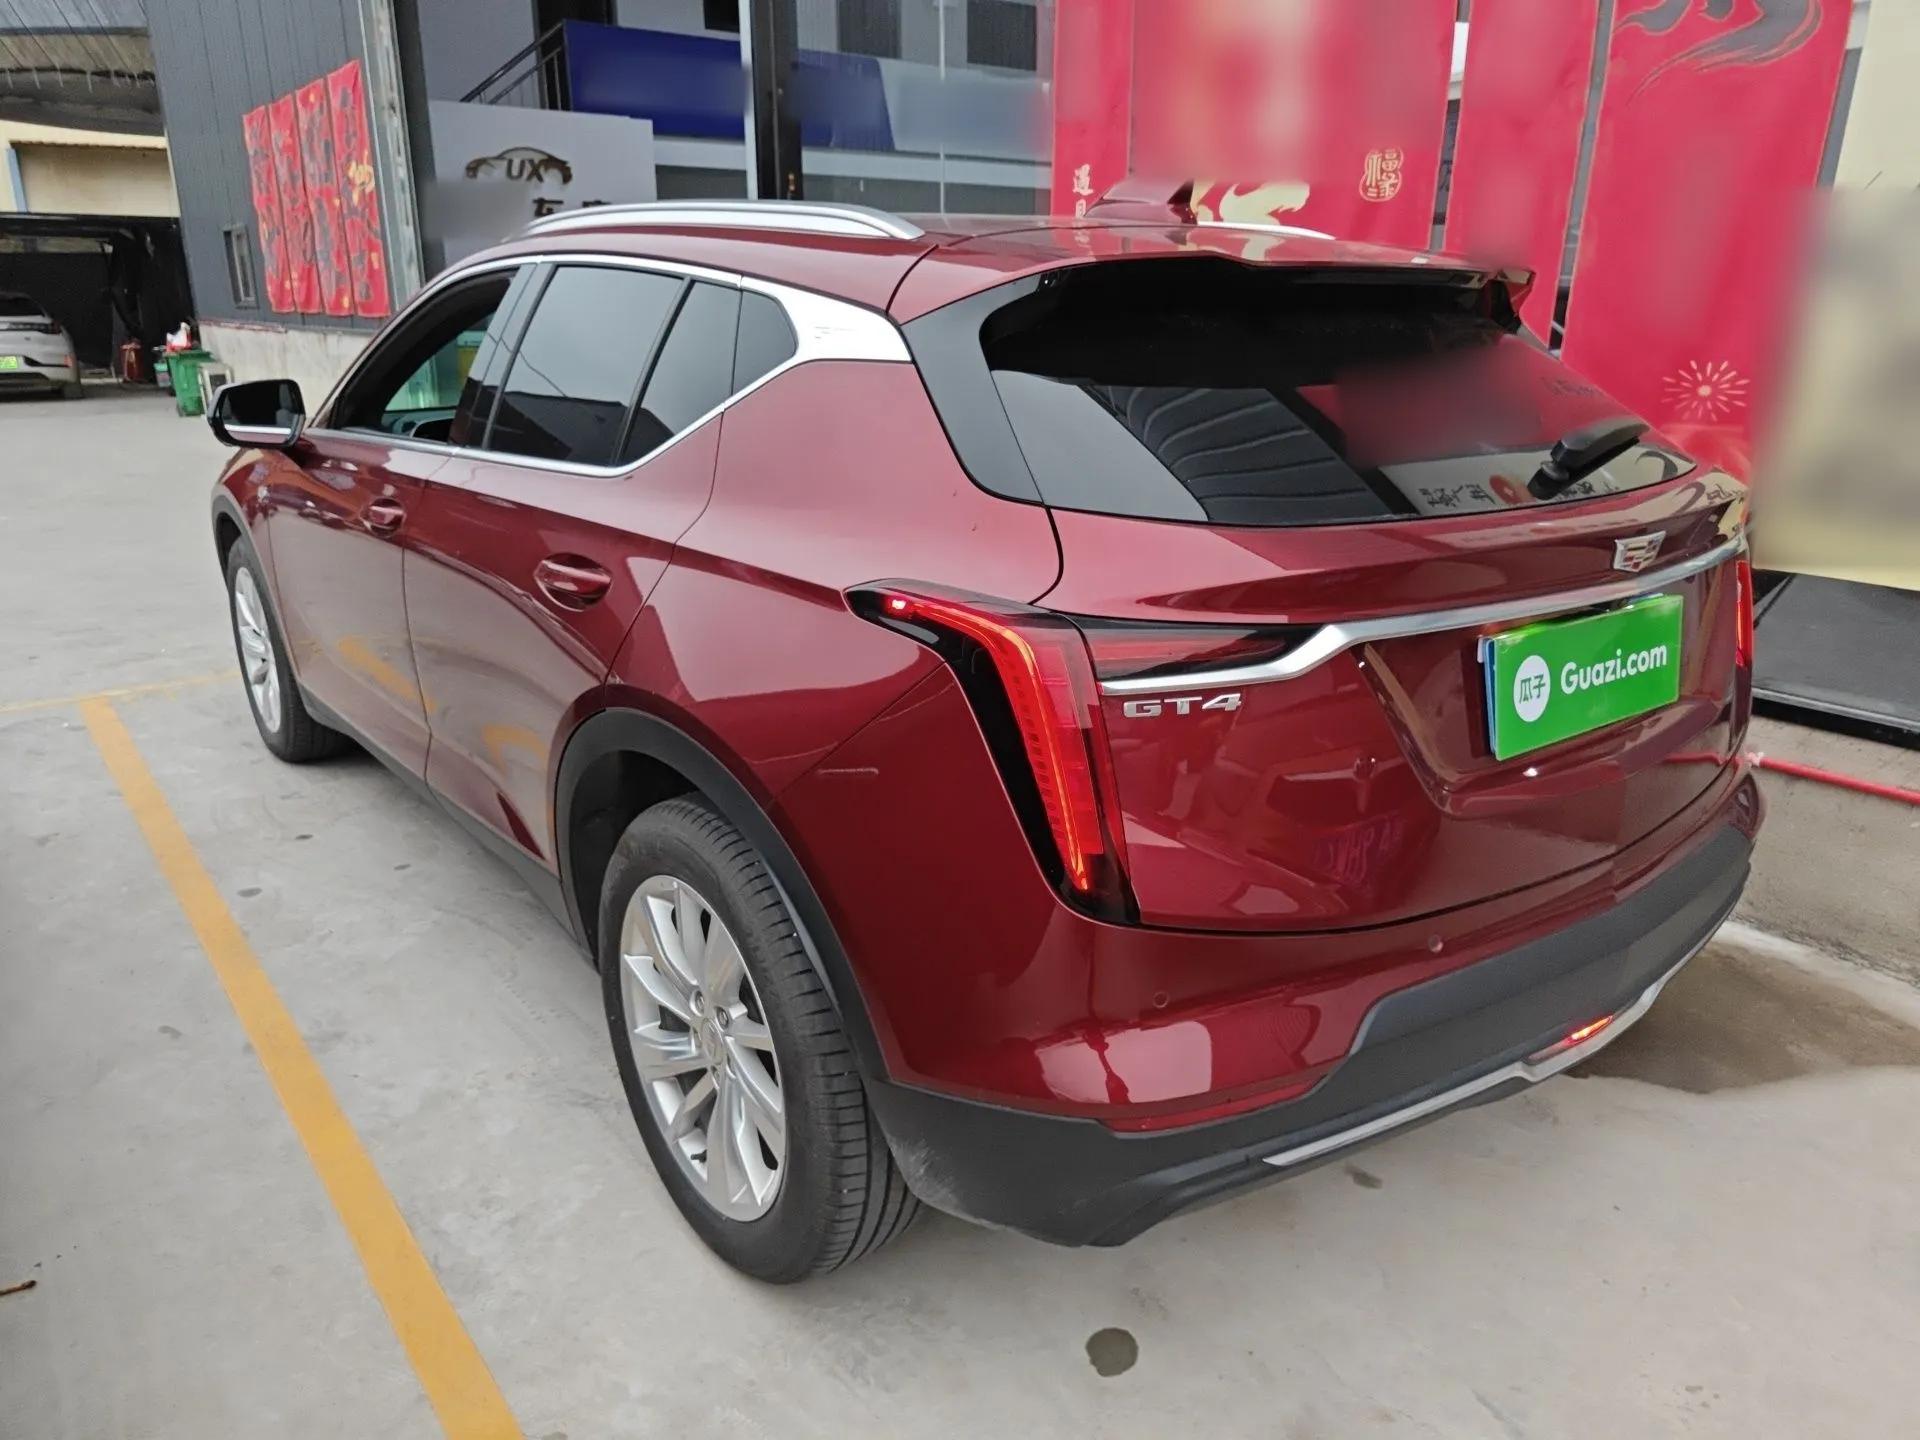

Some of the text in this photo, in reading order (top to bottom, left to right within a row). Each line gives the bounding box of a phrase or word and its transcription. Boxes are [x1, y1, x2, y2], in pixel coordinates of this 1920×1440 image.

[1561, 644, 1667, 695] Guazi.com
[1519, 673, 1546, 704] 瓜子
[1123, 693, 1241, 718] GT4
